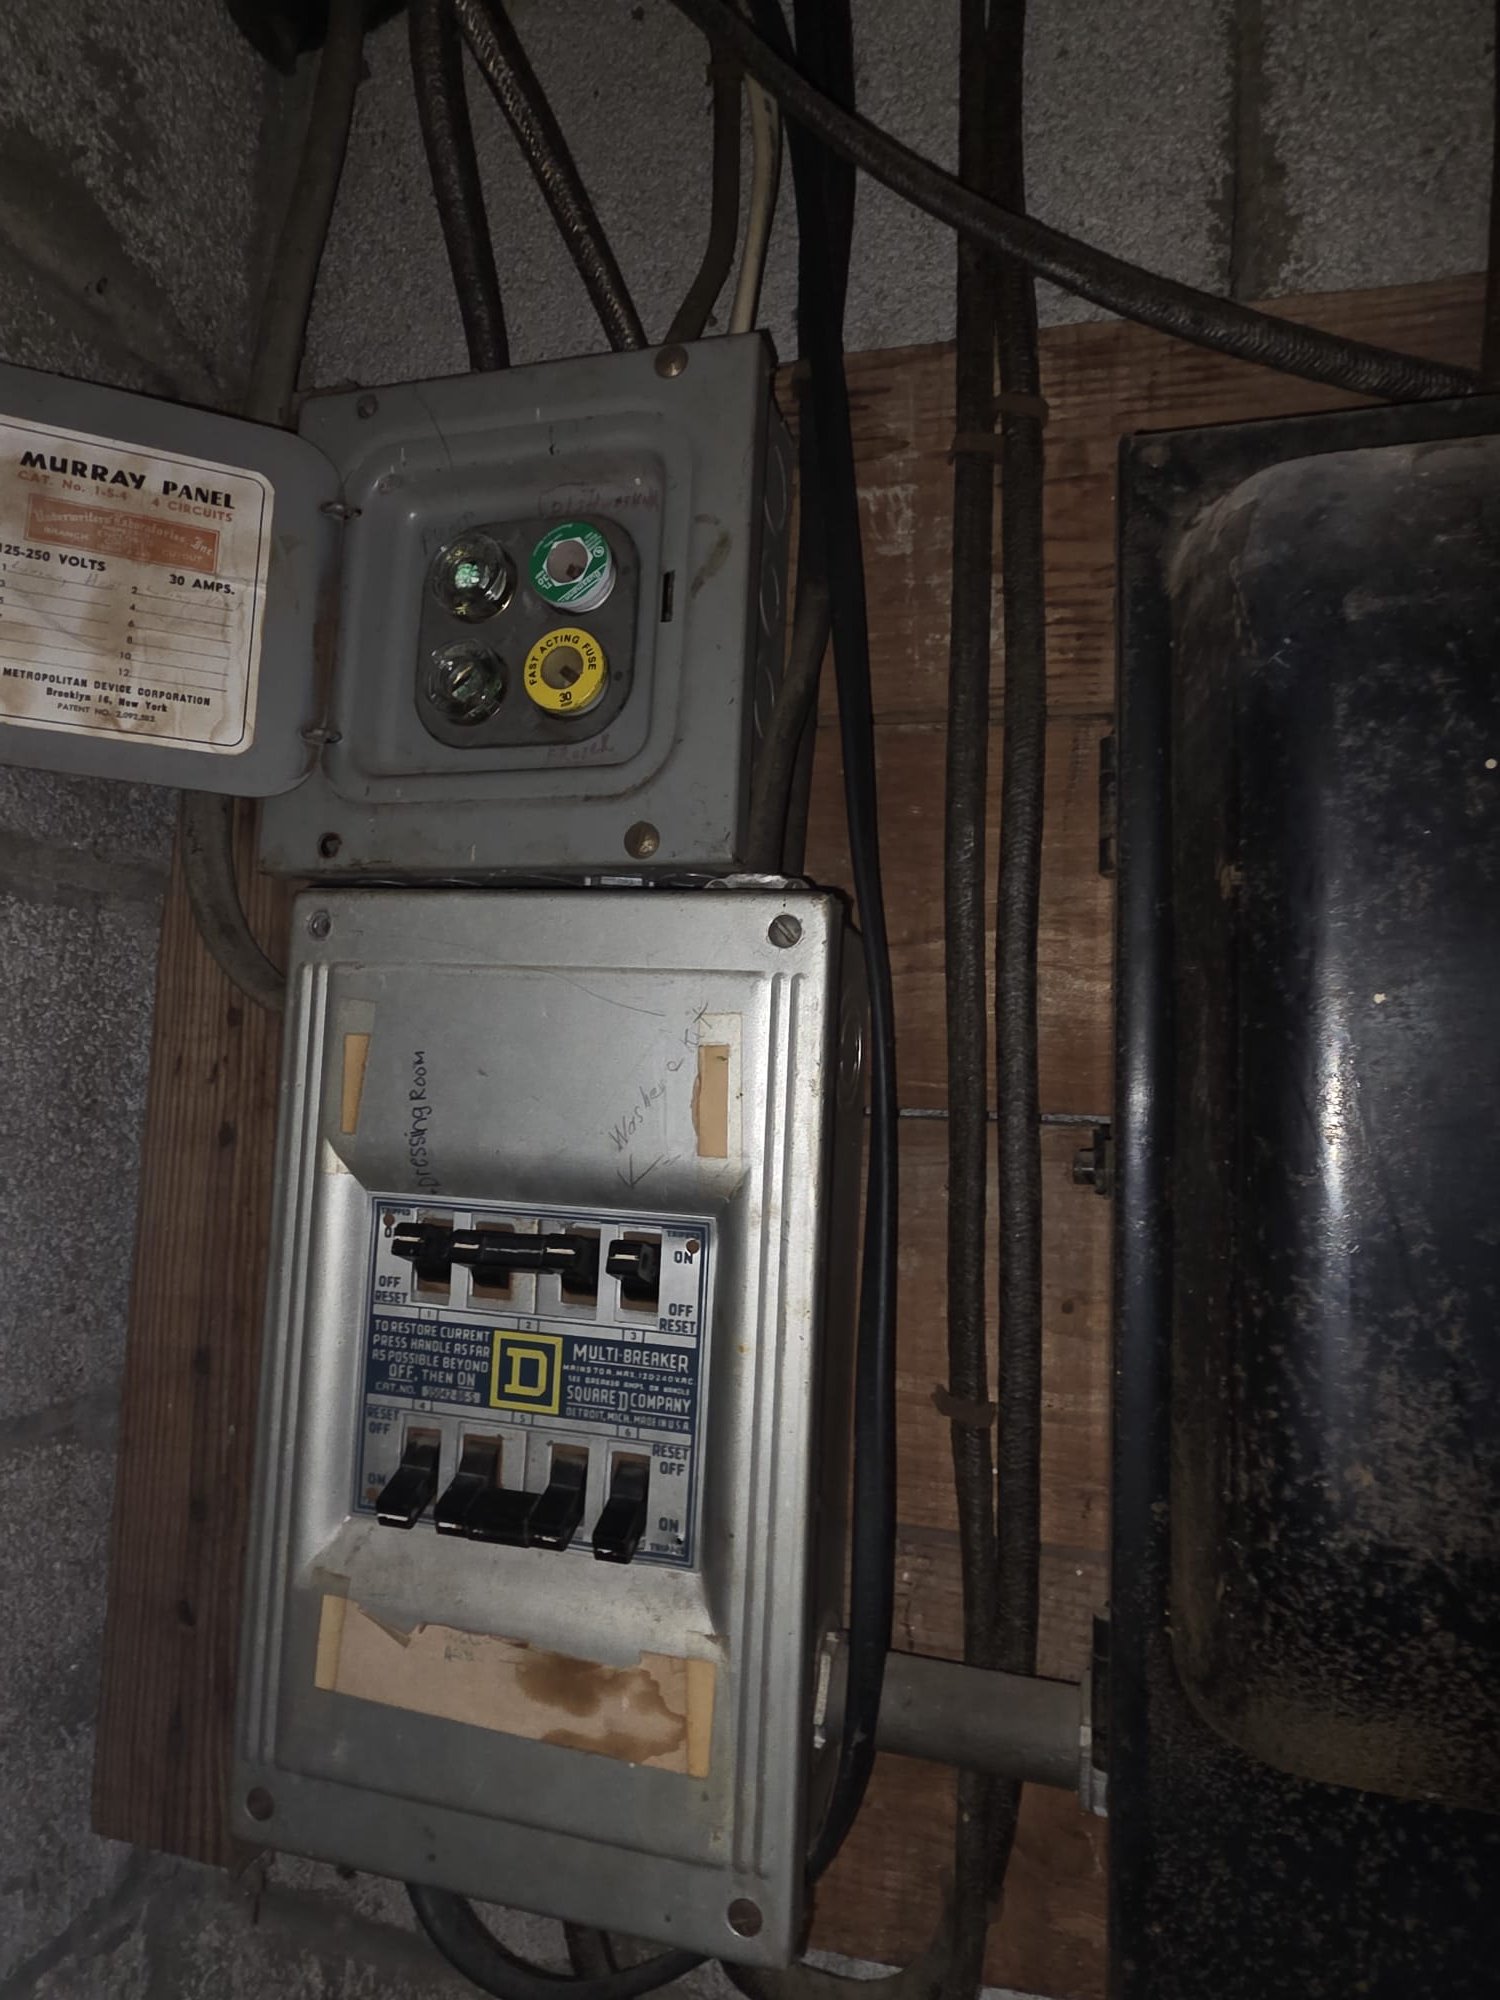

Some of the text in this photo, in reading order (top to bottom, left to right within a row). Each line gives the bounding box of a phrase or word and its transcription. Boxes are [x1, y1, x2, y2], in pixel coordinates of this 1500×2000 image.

[20, 451, 236, 510] MURRAY PANEL
[17, 470, 54, 487] CAT.
[151, 498, 160, 509] 4
[167, 500, 234, 523] CIRCUITS
[59, 553, 107, 572] VOLTS
[169, 574, 185, 587] 30
[192, 577, 236, 596] AMPS.
[131, 586, 138, 595] 2
[120, 651, 131, 661] 10
[528, 634, 597, 686] FAST ACTING FUSE
[3, 666, 211, 707] METROPOLITAN DEVICE CORPORATION
[46, 687, 91, 704] Brooklyn
[118, 698, 138, 710] New
[144, 701, 168, 713] York
[559, 691, 572, 703] 30
[57, 703, 90, 714] PATENT
[674, 1250, 694, 1265] ON
[378, 1275, 402, 1289] OFF
[374, 1290, 408, 1304] RESET
[668, 1303, 695, 1317] OFF
[374, 1319, 491, 1342] TO RESTORE CURRENT
[525, 1320, 533, 1330] 2
[659, 1317, 697, 1334] RESET
[630, 1331, 637, 1341] 3
[372, 1334, 491, 1358] PRESS HANDLE AS FAR
[372, 1348, 489, 1373] AS POSSIBLE BEYOND
[572, 1343, 690, 1374] MULTI-BREAKER
[421, 1369, 454, 1384] THEN
[457, 1372, 477, 1387] ON
[566, 1385, 692, 1414] SQUARE D COMPANY
[366, 1407, 400, 1421] RESET
[519, 1414, 526, 1423] 5
[633, 1415, 656, 1427] MADE
[657, 1418, 667, 1428] IN
[369, 1421, 391, 1435] OFF
[652, 1443, 689, 1460] RESET
[660, 1461, 685, 1477] OFF
[368, 1472, 386, 1486] ON
[658, 1517, 680, 1533] ON
